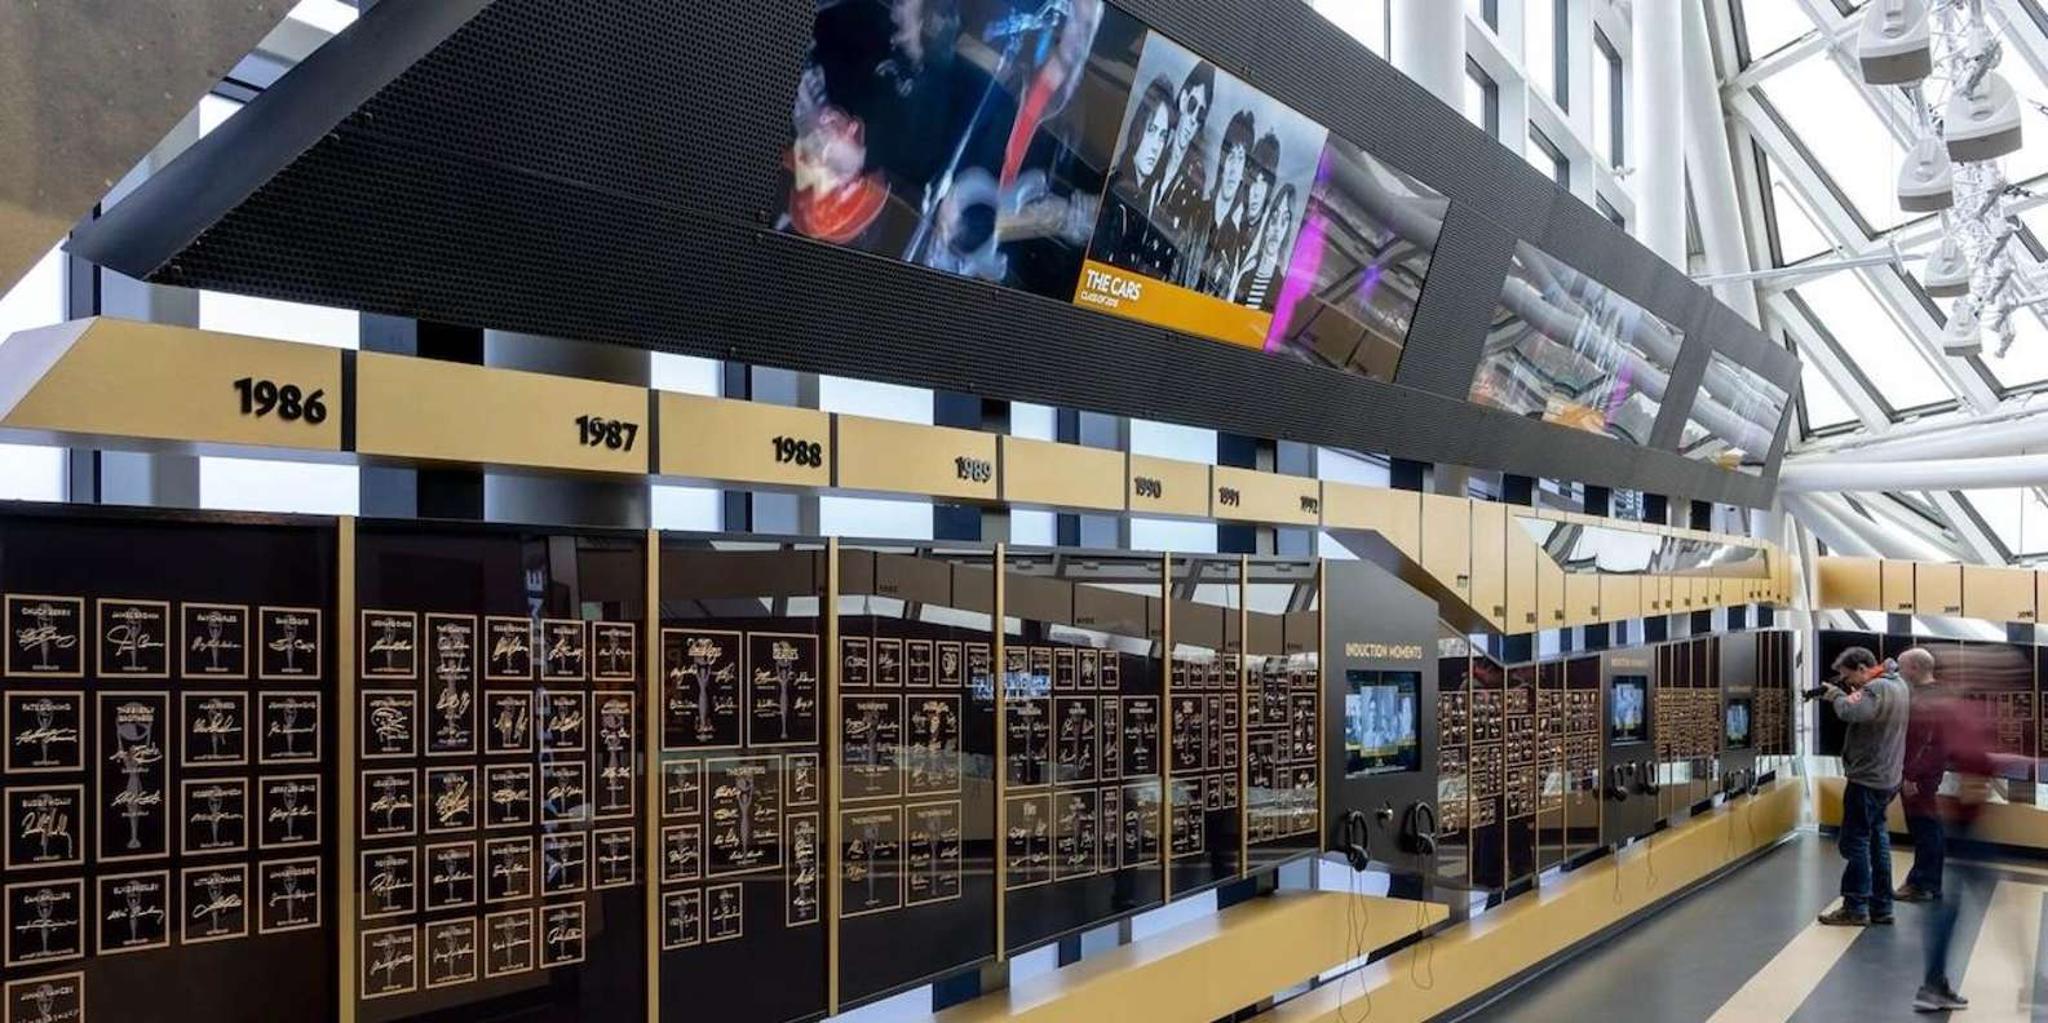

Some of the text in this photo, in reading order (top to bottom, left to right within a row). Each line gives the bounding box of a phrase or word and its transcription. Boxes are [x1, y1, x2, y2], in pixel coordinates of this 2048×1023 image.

[1087, 269, 1142, 301] THE CARS
[234, 377, 327, 425] 1986
[576, 415, 638, 452] 1987
[772, 436, 822, 468] 1988
[954, 456, 992, 483] 1989
[1134, 476, 1162, 498] 1990
[1219, 486, 1240, 507] 1991
[1345, 642, 1423, 660] INDUCTION MOMENTS
